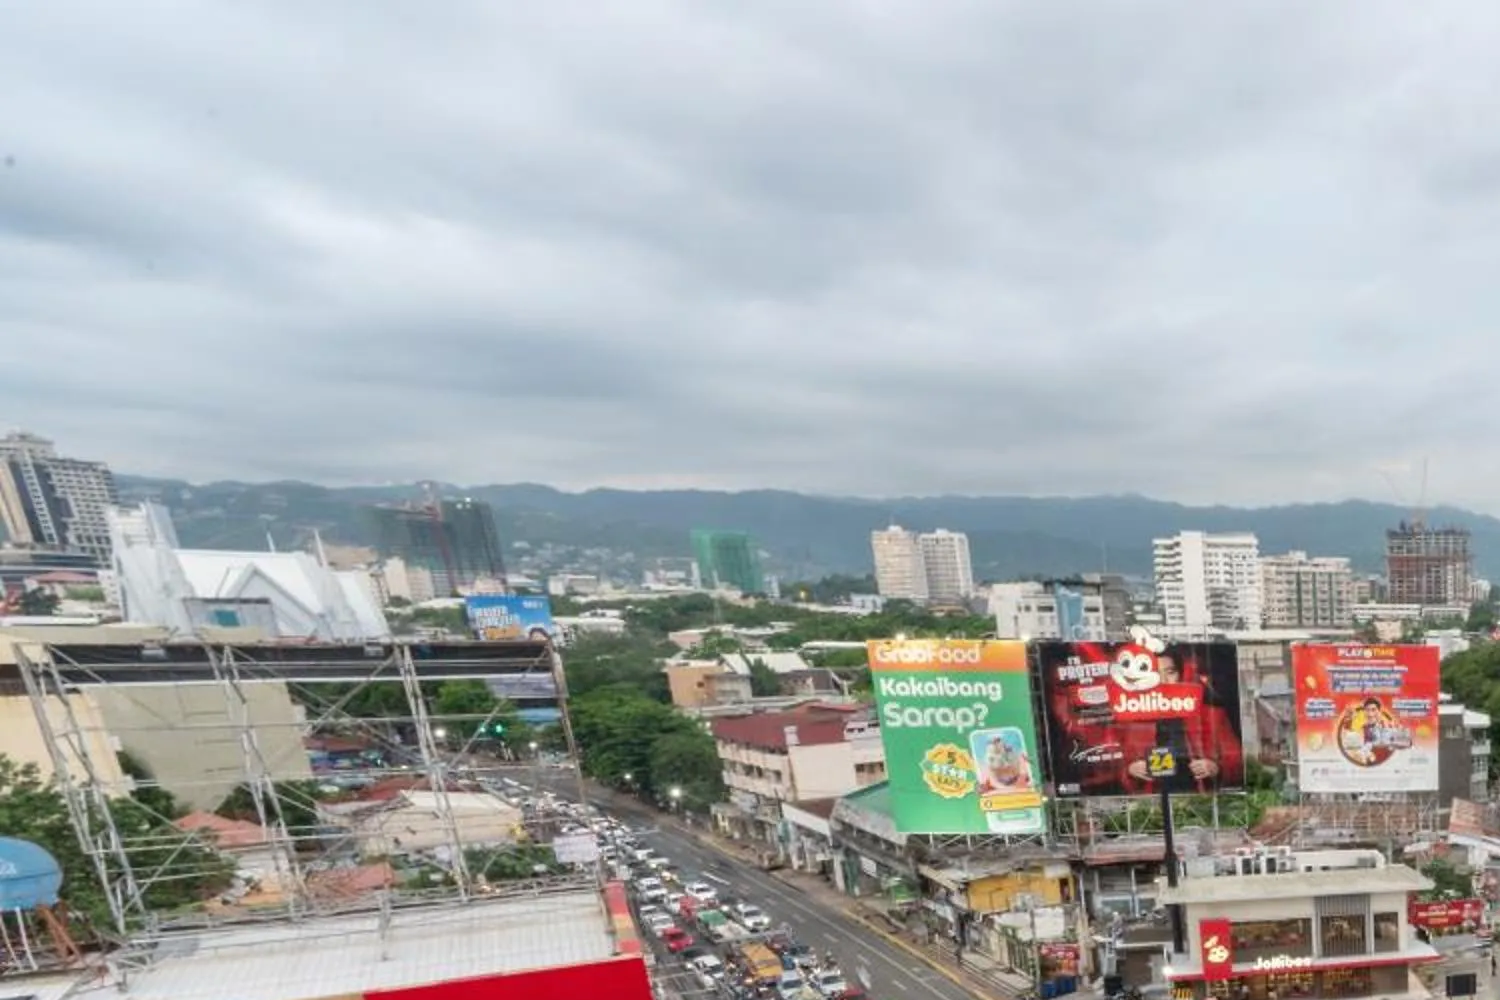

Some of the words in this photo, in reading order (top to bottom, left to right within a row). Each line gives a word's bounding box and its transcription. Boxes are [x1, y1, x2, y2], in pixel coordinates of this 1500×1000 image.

[1113, 691, 1197, 713] Jollibee
[883, 703, 989, 734] Sarap?
[1149, 752, 1176, 771] 24
[1252, 954, 1313, 971] Jollibee
